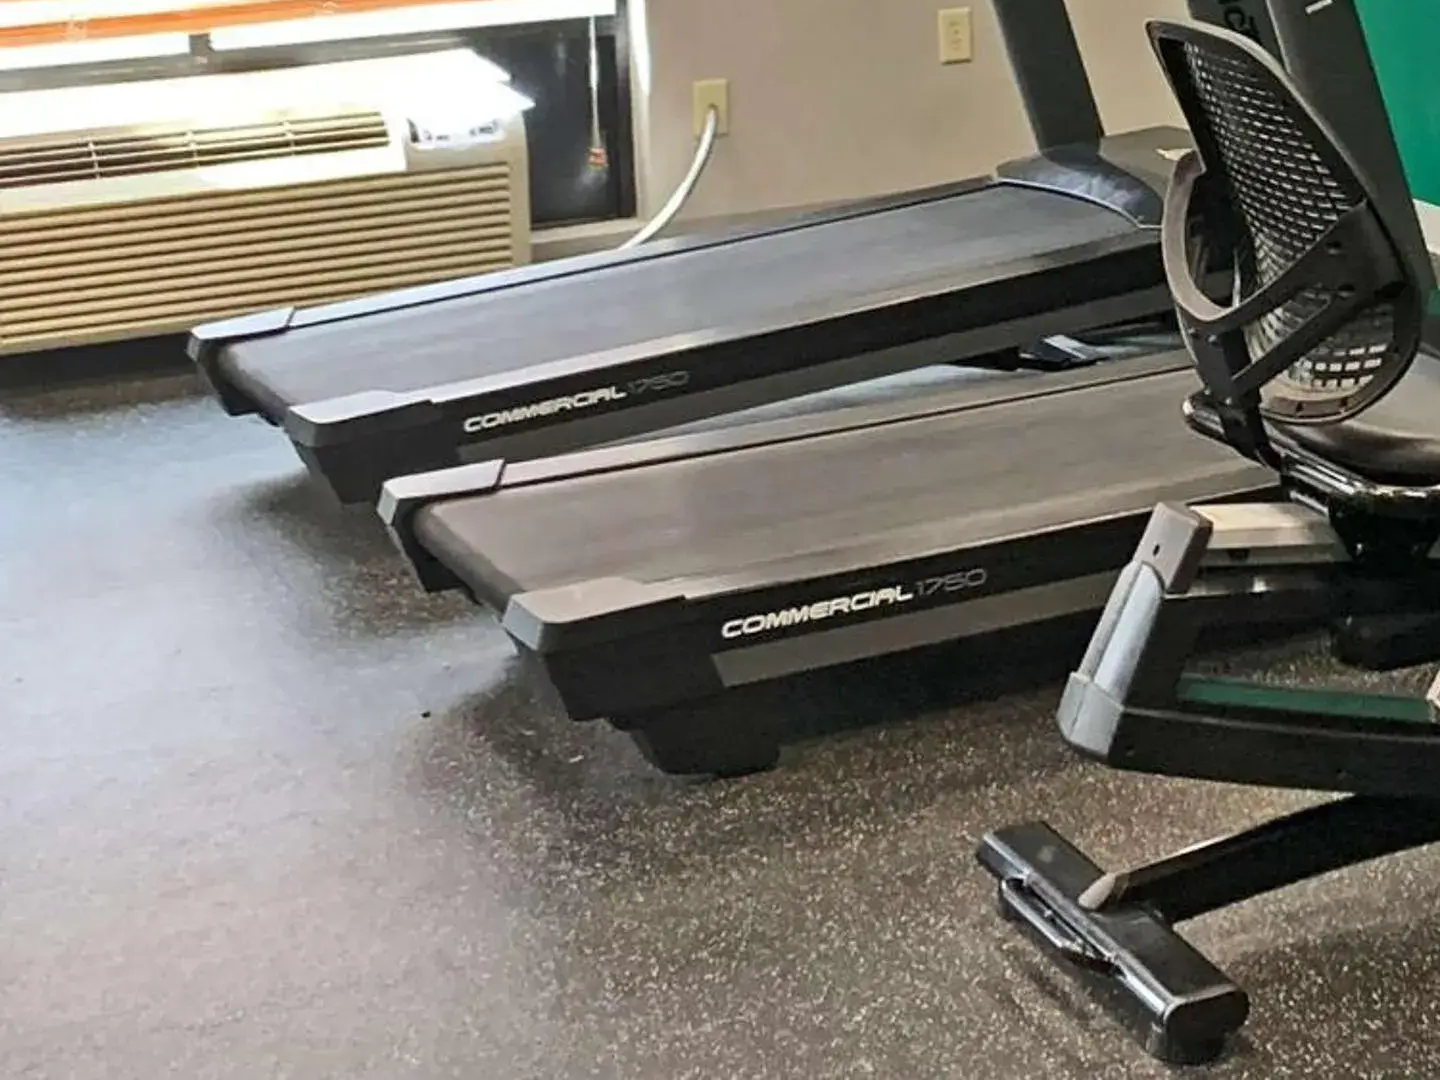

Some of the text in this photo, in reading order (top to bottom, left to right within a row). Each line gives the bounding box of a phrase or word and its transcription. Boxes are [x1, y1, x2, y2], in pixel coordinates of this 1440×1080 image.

[463, 385, 627, 434] COMMERCIAL
[721, 568, 988, 639] COMMERCIAL 1750
